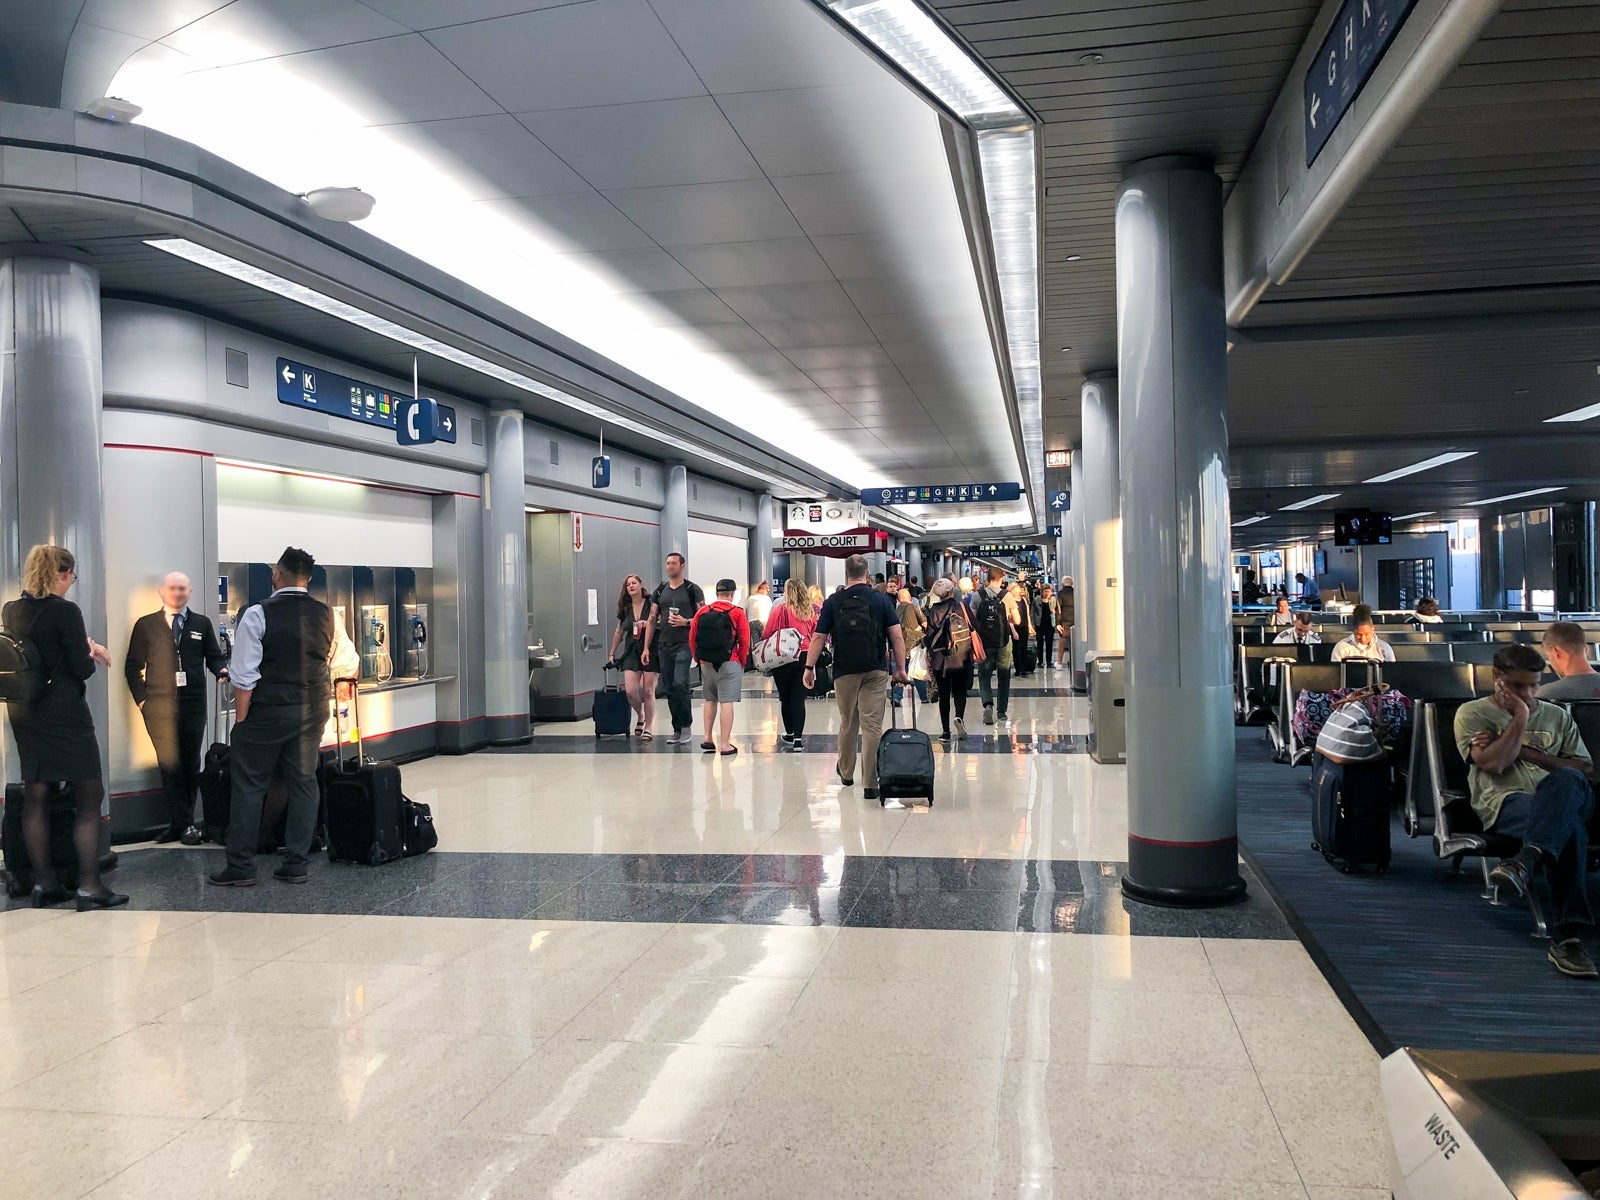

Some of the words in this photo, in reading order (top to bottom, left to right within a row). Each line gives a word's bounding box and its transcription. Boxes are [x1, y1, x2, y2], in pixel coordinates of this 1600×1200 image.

[1328, 50, 1337, 87] G
[1345, 16, 1353, 60] H
[304, 373, 313, 390] K
[1048, 450, 1069, 465] EXIT
[783, 536, 815, 548] FOOD
[820, 536, 858, 547] COURT
[1424, 1112, 1461, 1160] WASTE
